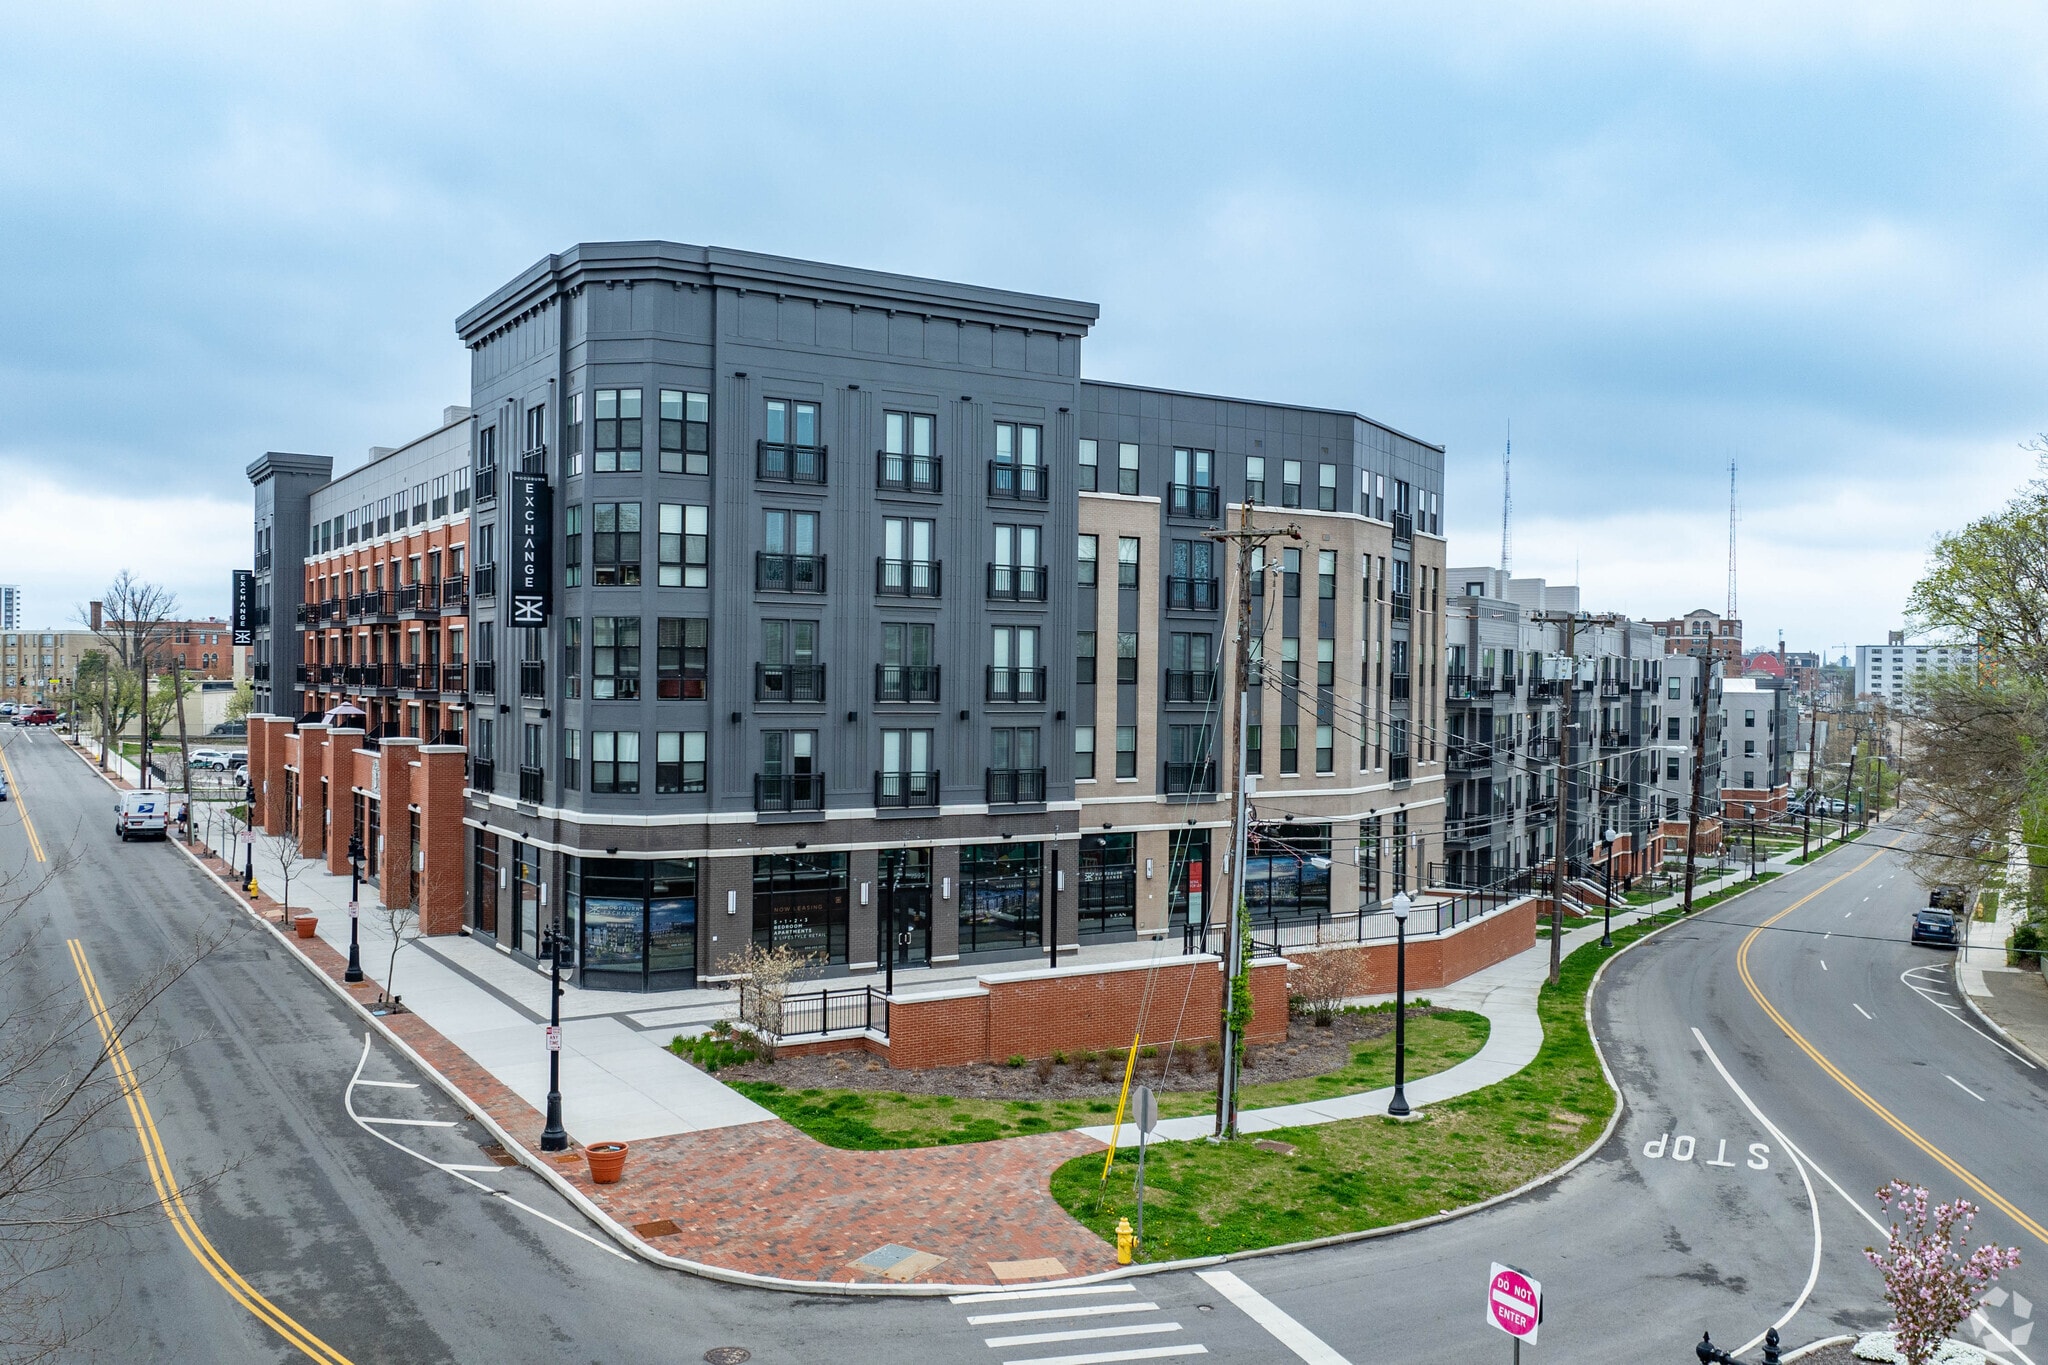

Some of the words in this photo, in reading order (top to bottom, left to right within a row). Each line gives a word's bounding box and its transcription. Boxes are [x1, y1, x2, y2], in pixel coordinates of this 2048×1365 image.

[524, 483, 535, 588] EXCHANGE
[773, 928, 812, 936] APARTMENTS
[1643, 1133, 1770, 1170] STOP
[1497, 1278, 1509, 1291] DO
[1514, 1285, 1532, 1301] NOT
[1498, 1306, 1526, 1328] ENTER
